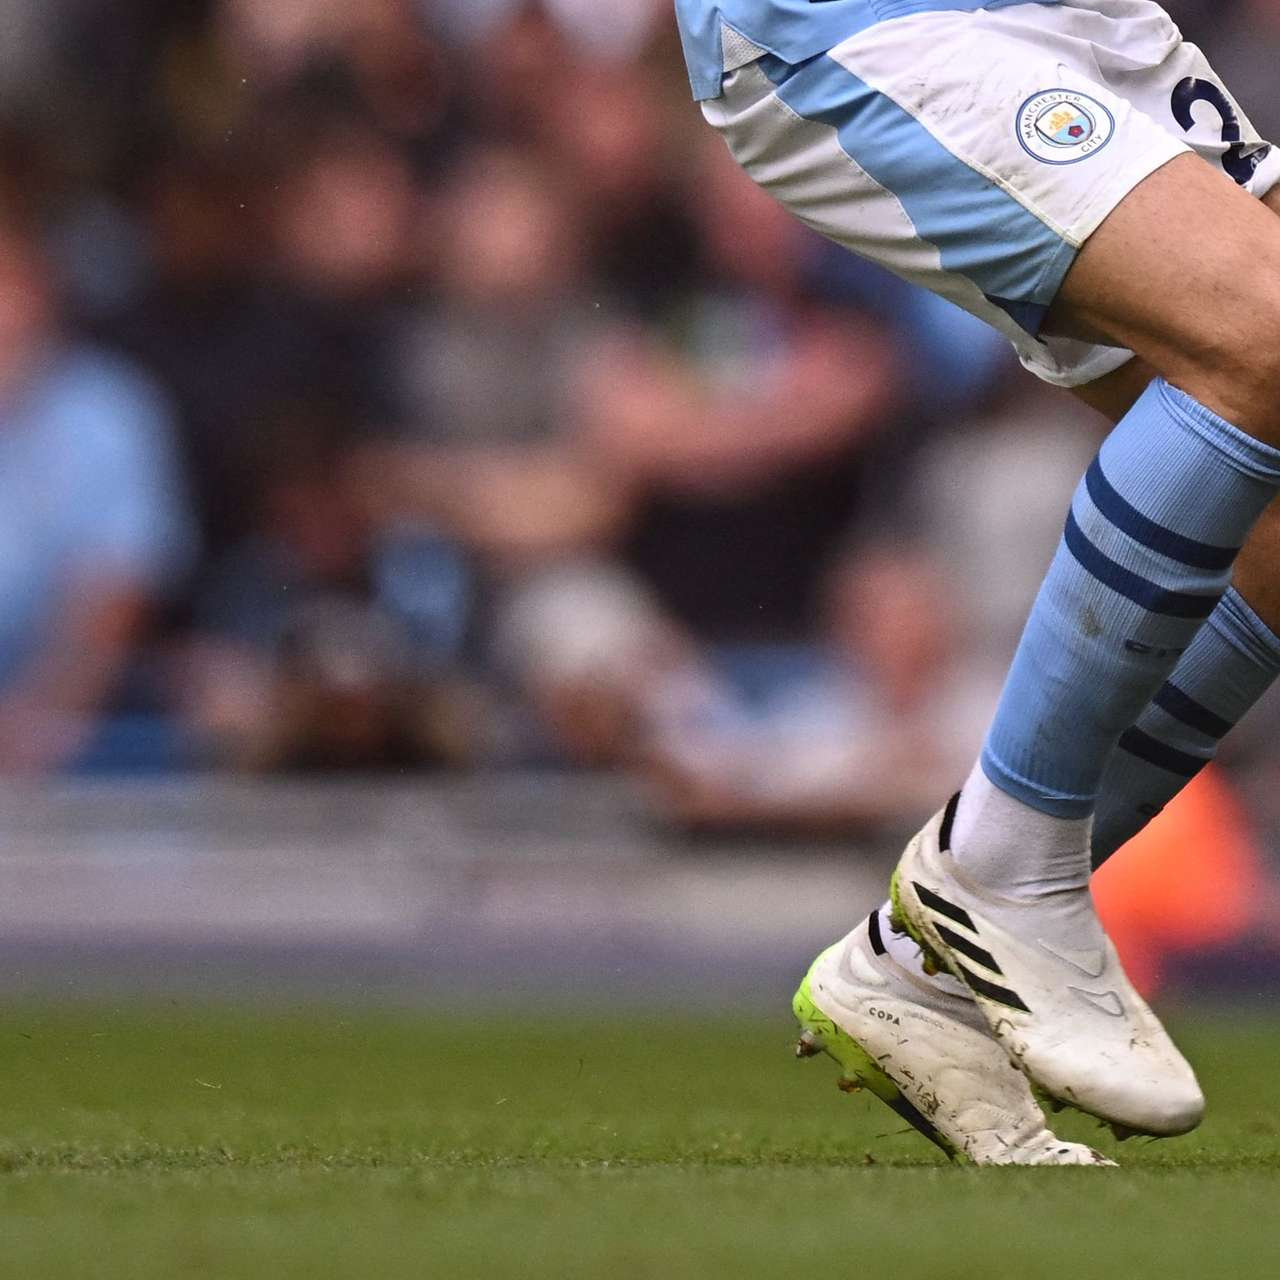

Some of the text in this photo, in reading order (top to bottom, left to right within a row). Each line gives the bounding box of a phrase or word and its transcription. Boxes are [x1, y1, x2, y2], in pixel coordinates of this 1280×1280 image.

[1023, 93, 1081, 139] MANCHESTER
[1080, 133, 1103, 153] CITY
[868, 1007, 900, 1026] COPA
